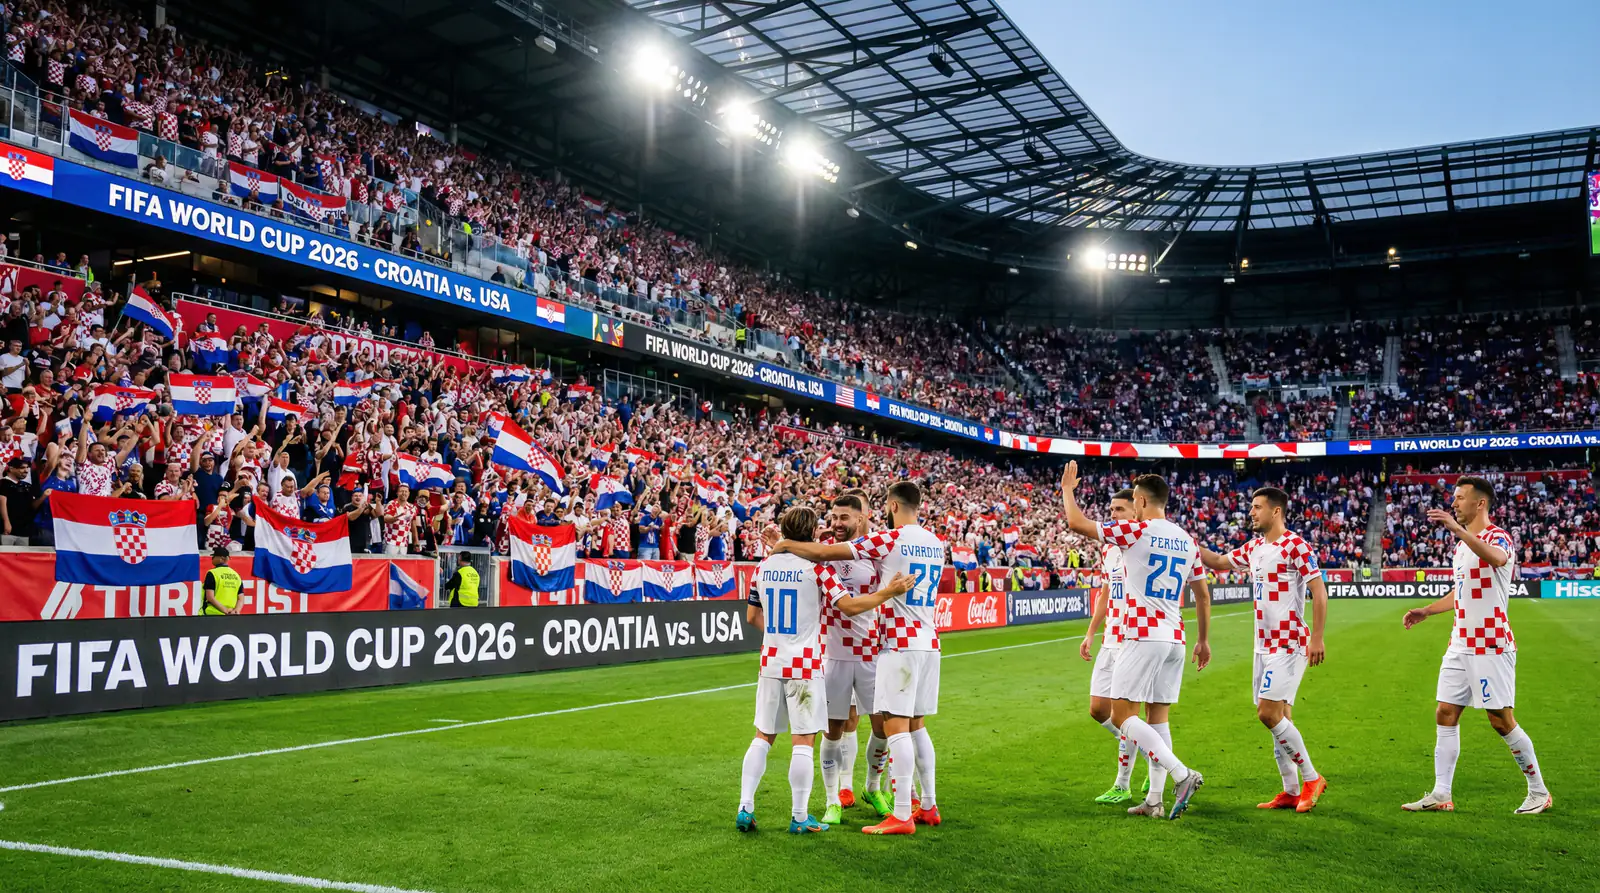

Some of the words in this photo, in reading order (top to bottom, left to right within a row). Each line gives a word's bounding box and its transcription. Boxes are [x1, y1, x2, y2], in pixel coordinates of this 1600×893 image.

[109, 183, 164, 220] FIFA
[169, 199, 255, 243] WORLD
[260, 226, 305, 255] CUP
[308, 239, 359, 271] 2026
[374, 258, 451, 297] CROATIA
[454, 284, 476, 303] vs.
[480, 287, 511, 312] USA
[645, 333, 670, 357] FIFA
[671, 341, 709, 366] WORLD
[710, 352, 730, 371] CUP
[731, 359, 754, 378] 2026
[760, 367, 796, 390] CROATIA
[796, 379, 808, 392] vs.
[808, 380, 824, 397] USA
[889, 403, 901, 417] FIFA
[1394, 441, 1417, 451] FIFA
[1419, 439, 1461, 450] WORLD
[1463, 438, 1488, 448] CUP
[1489, 436, 1519, 447] 2026
[1528, 434, 1582, 446] CROATIA
[763, 569, 803, 582] MODRIĆ
[906, 563, 941, 606] 28
[1145, 553, 1186, 601] 25
[1112, 582, 1123, 599] 20
[1328, 585, 1359, 597] FIFA
[1360, 584, 1416, 597] WORLD
[1418, 584, 1450, 596] CUP
[1509, 583, 1529, 596] SA
[765, 588, 798, 635] 10
[1015, 599, 1031, 616] FIFA
[1031, 598, 1054, 615] WORLD
[1055, 597, 1067, 613] CUP
[16, 639, 148, 697] FIFA
[158, 630, 335, 686] WORLD
[345, 626, 425, 672] CUP
[433, 621, 517, 665] 2026
[523, 637, 534, 646] -
[542, 615, 660, 657] CROATIA
[664, 621, 696, 646] vs.
[700, 611, 744, 644] USA
[1263, 670, 1273, 688] 5
[1480, 679, 1490, 697] 2
